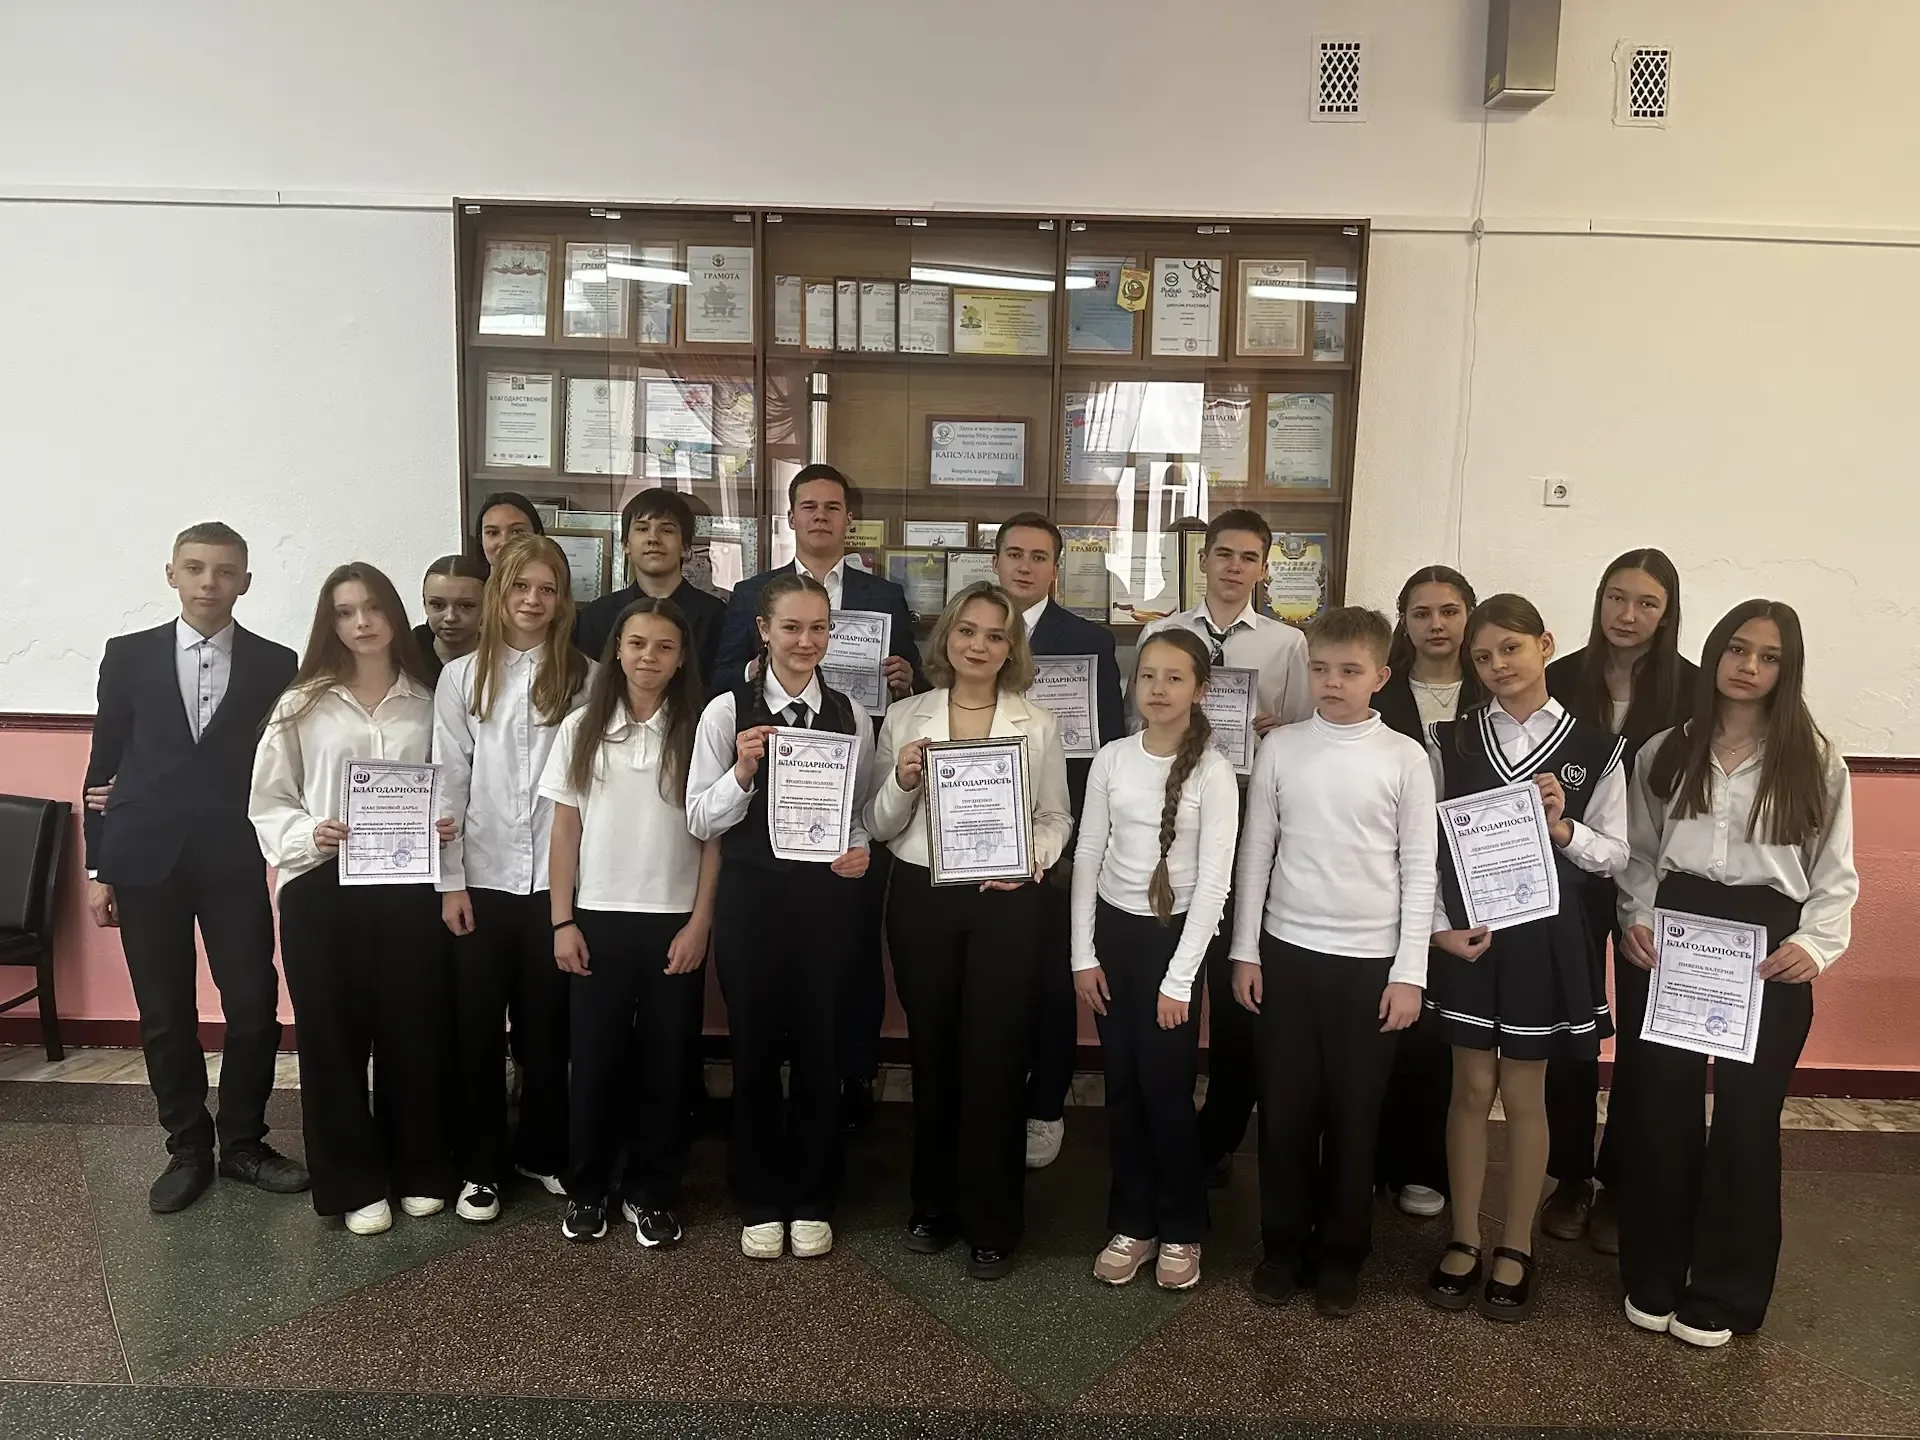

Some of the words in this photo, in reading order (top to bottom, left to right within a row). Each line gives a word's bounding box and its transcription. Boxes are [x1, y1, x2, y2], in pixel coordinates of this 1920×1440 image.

[936, 451, 975, 459] КАПСУЛА
[829, 634, 880, 643] АГОДАРНОСТЬ
[778, 760, 845, 770] БЛАГОДАРНОСТЬ
[941, 778, 1011, 788] БЛАГОДАРНОСТЬ
[1458, 816, 1533, 836] БЛАГОДАРНОСТЬ
[1666, 940, 1752, 959] БЛАГОДАРНОСТЬ
